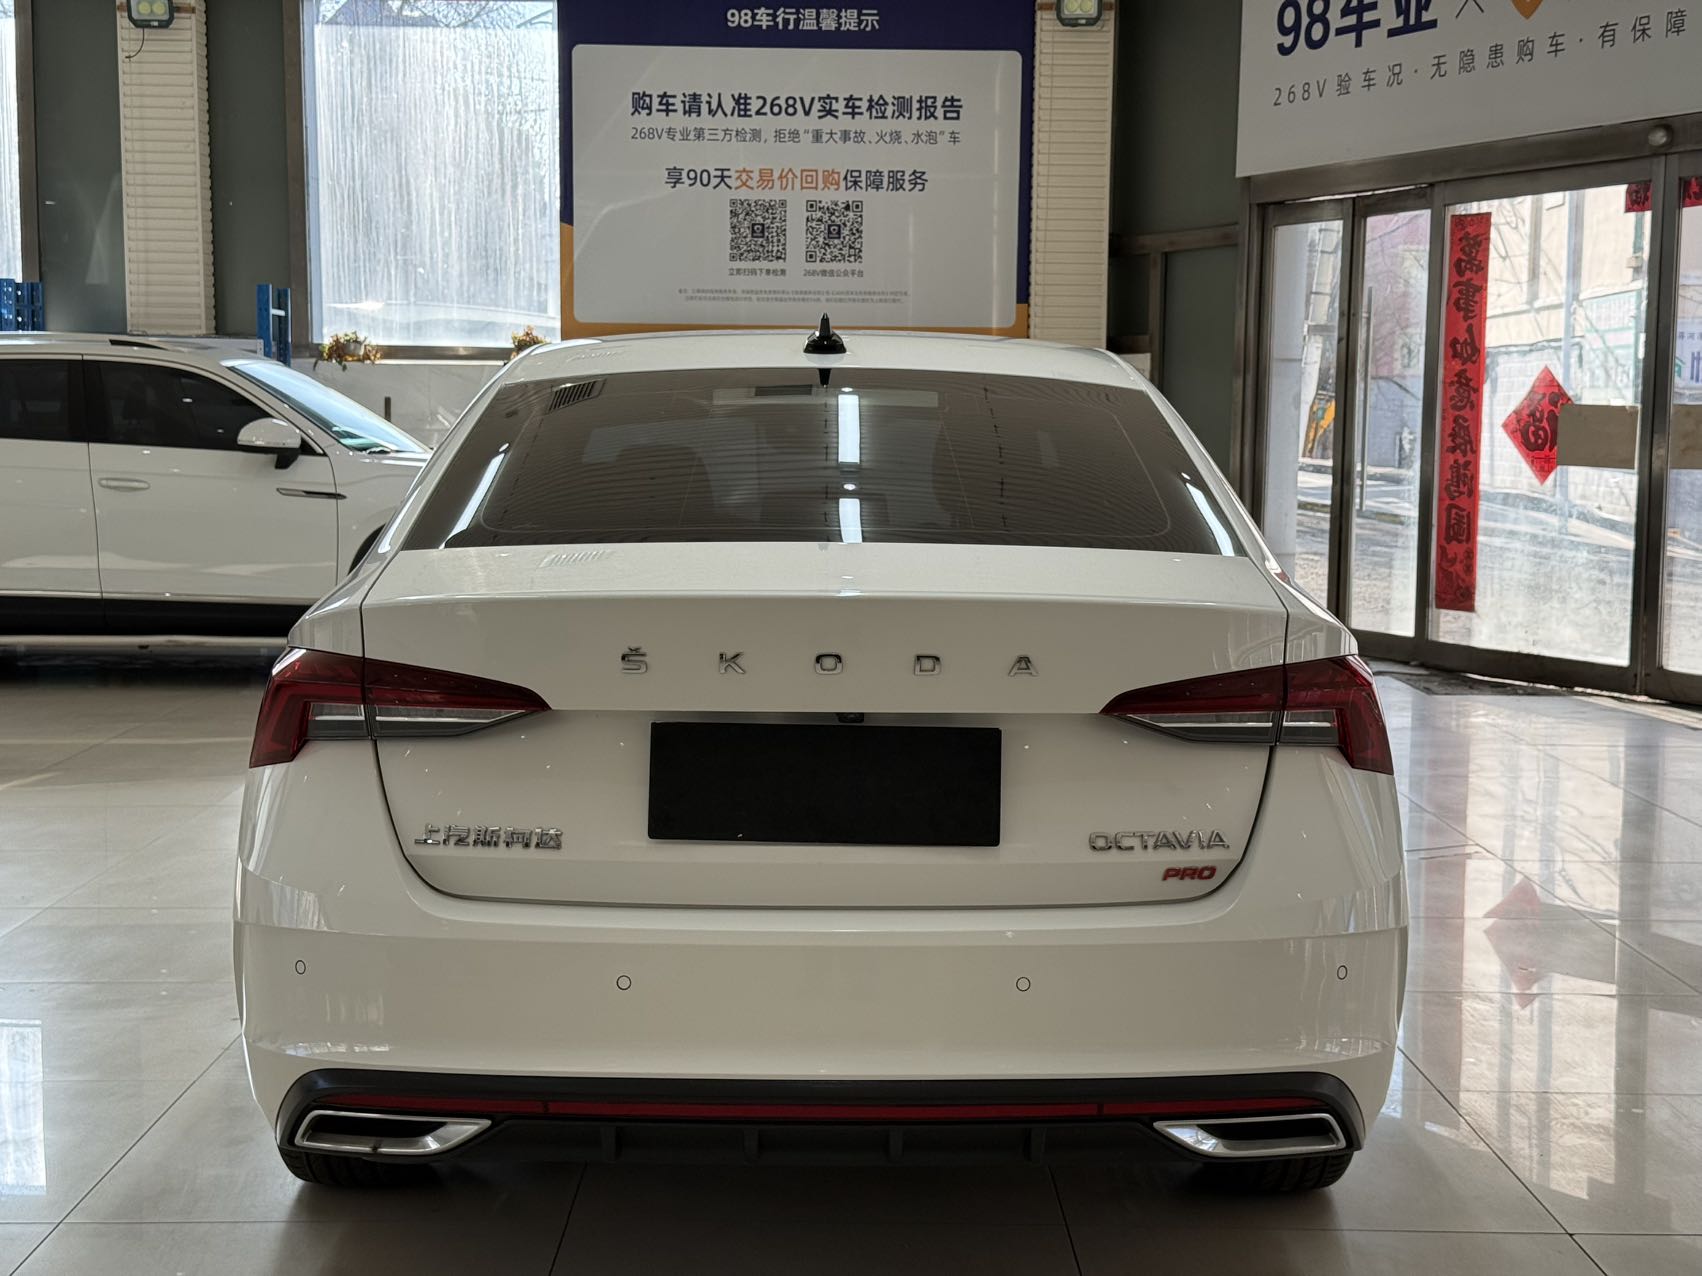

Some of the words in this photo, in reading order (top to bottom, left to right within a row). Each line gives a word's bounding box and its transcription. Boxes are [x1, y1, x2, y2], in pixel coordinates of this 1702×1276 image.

[726, 8, 880, 32] 98车行温馨提示
[630, 91, 964, 121] 购车请认准268V实车检测报告
[664, 166, 929, 193] 享90天交易价回购保障服务
[414, 823, 563, 849] 上汽斯柯达
[1088, 829, 1231, 851] OCTAVIA
[1162, 865, 1217, 881] PRO
